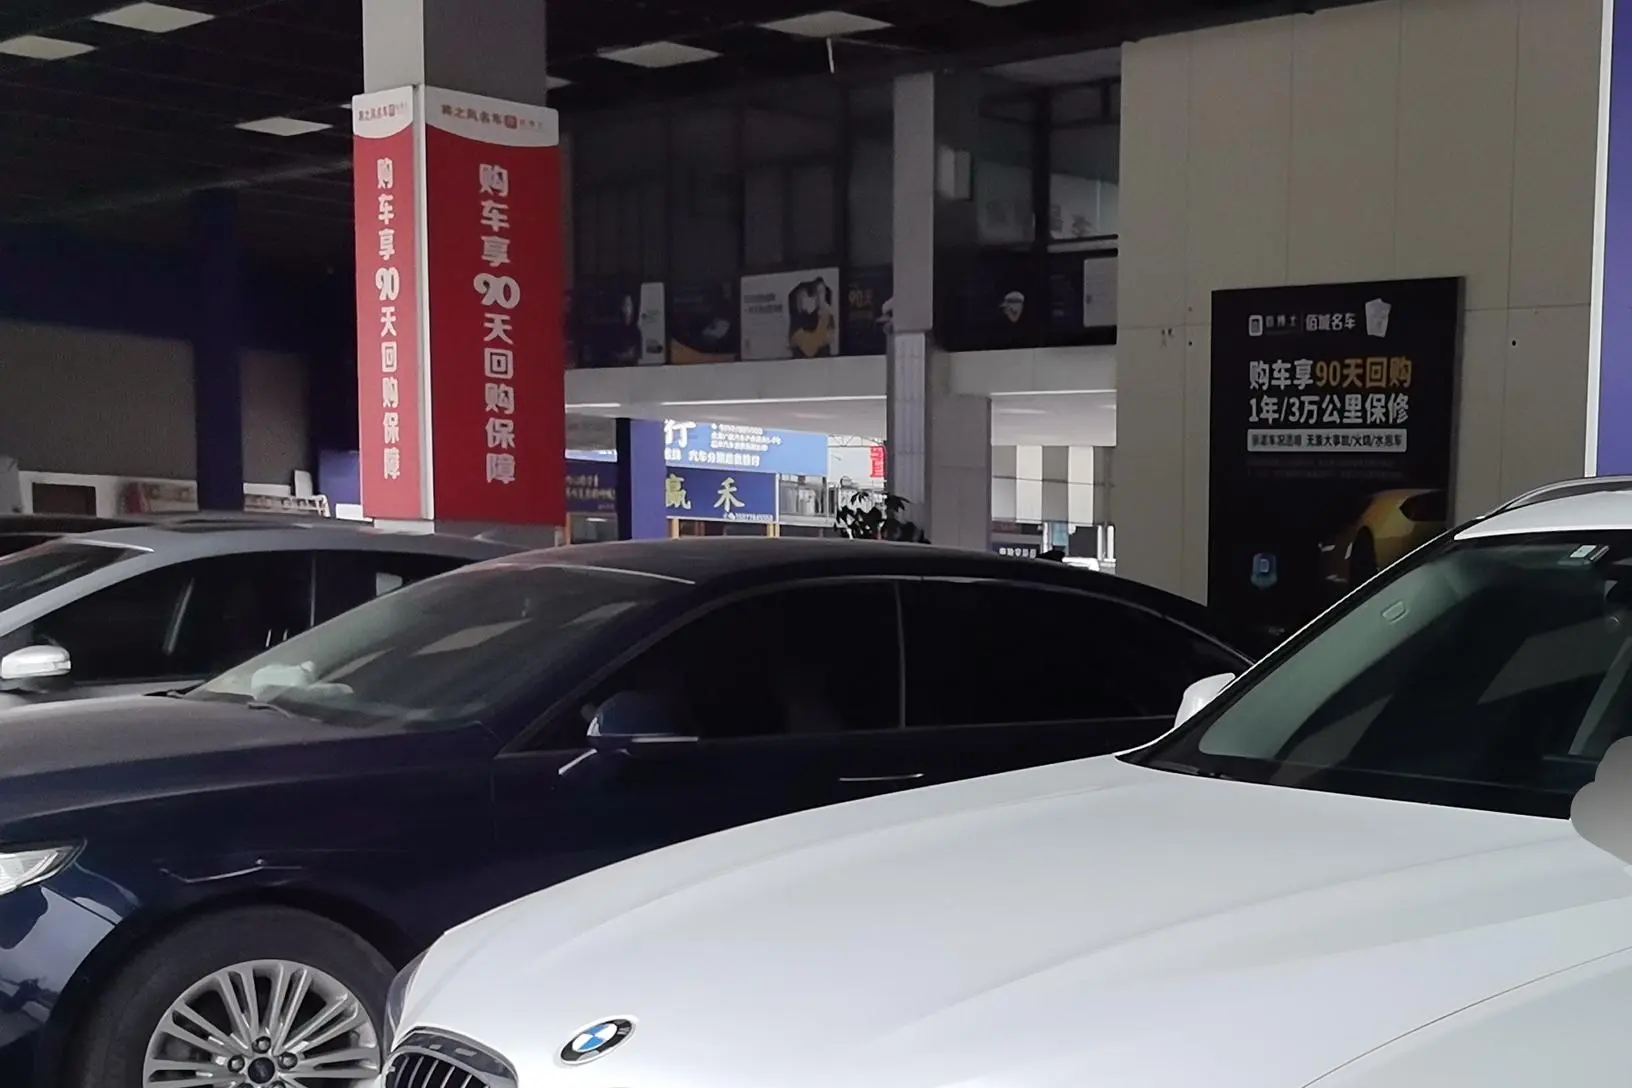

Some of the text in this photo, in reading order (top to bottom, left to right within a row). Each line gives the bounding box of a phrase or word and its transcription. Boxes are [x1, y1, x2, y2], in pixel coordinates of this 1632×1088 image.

[375, 157, 401, 480] 购车享90天回购保障
[473, 164, 521, 485] 购车享90天回购保障
[1249, 356, 1412, 390] 购车享90天回购
[1248, 393, 1409, 425] 1年/3万公里保修
